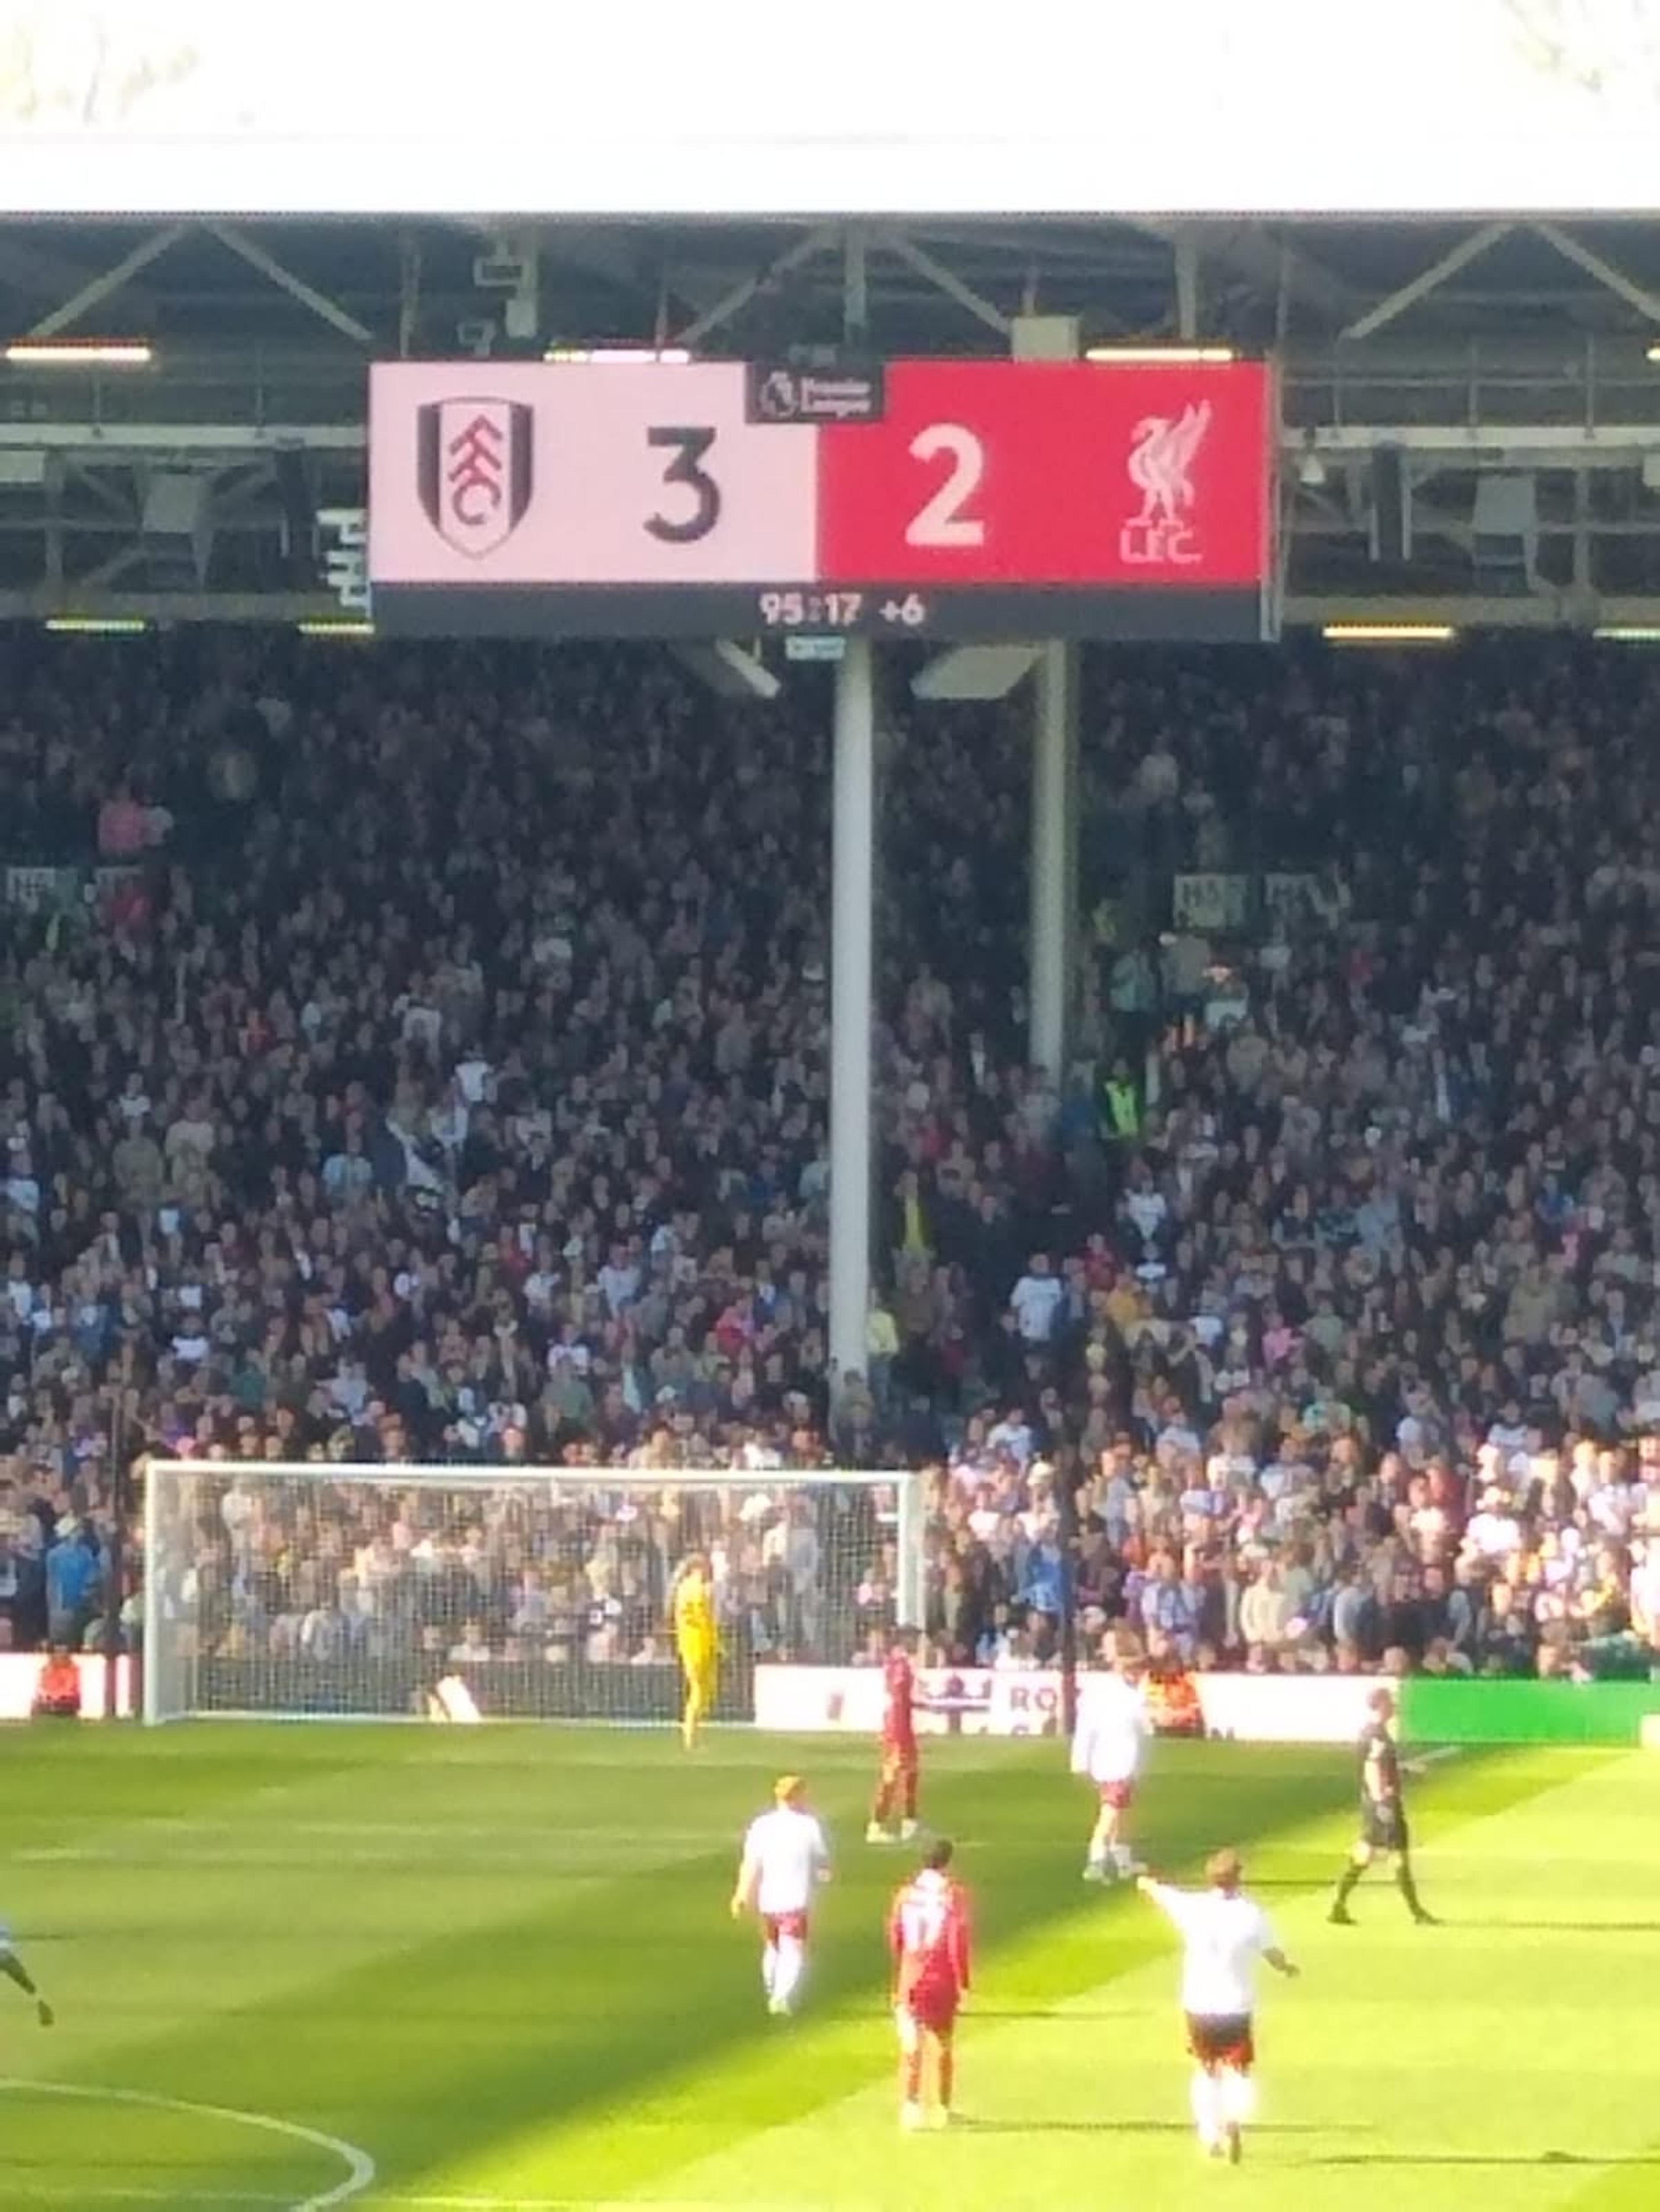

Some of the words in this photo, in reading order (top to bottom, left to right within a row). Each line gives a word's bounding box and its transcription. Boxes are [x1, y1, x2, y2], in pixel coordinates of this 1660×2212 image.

[643, 426, 721, 543] 3
[905, 424, 985, 546] 2
[759, 592, 862, 626] 95:17
[879, 593, 926, 626] +6
